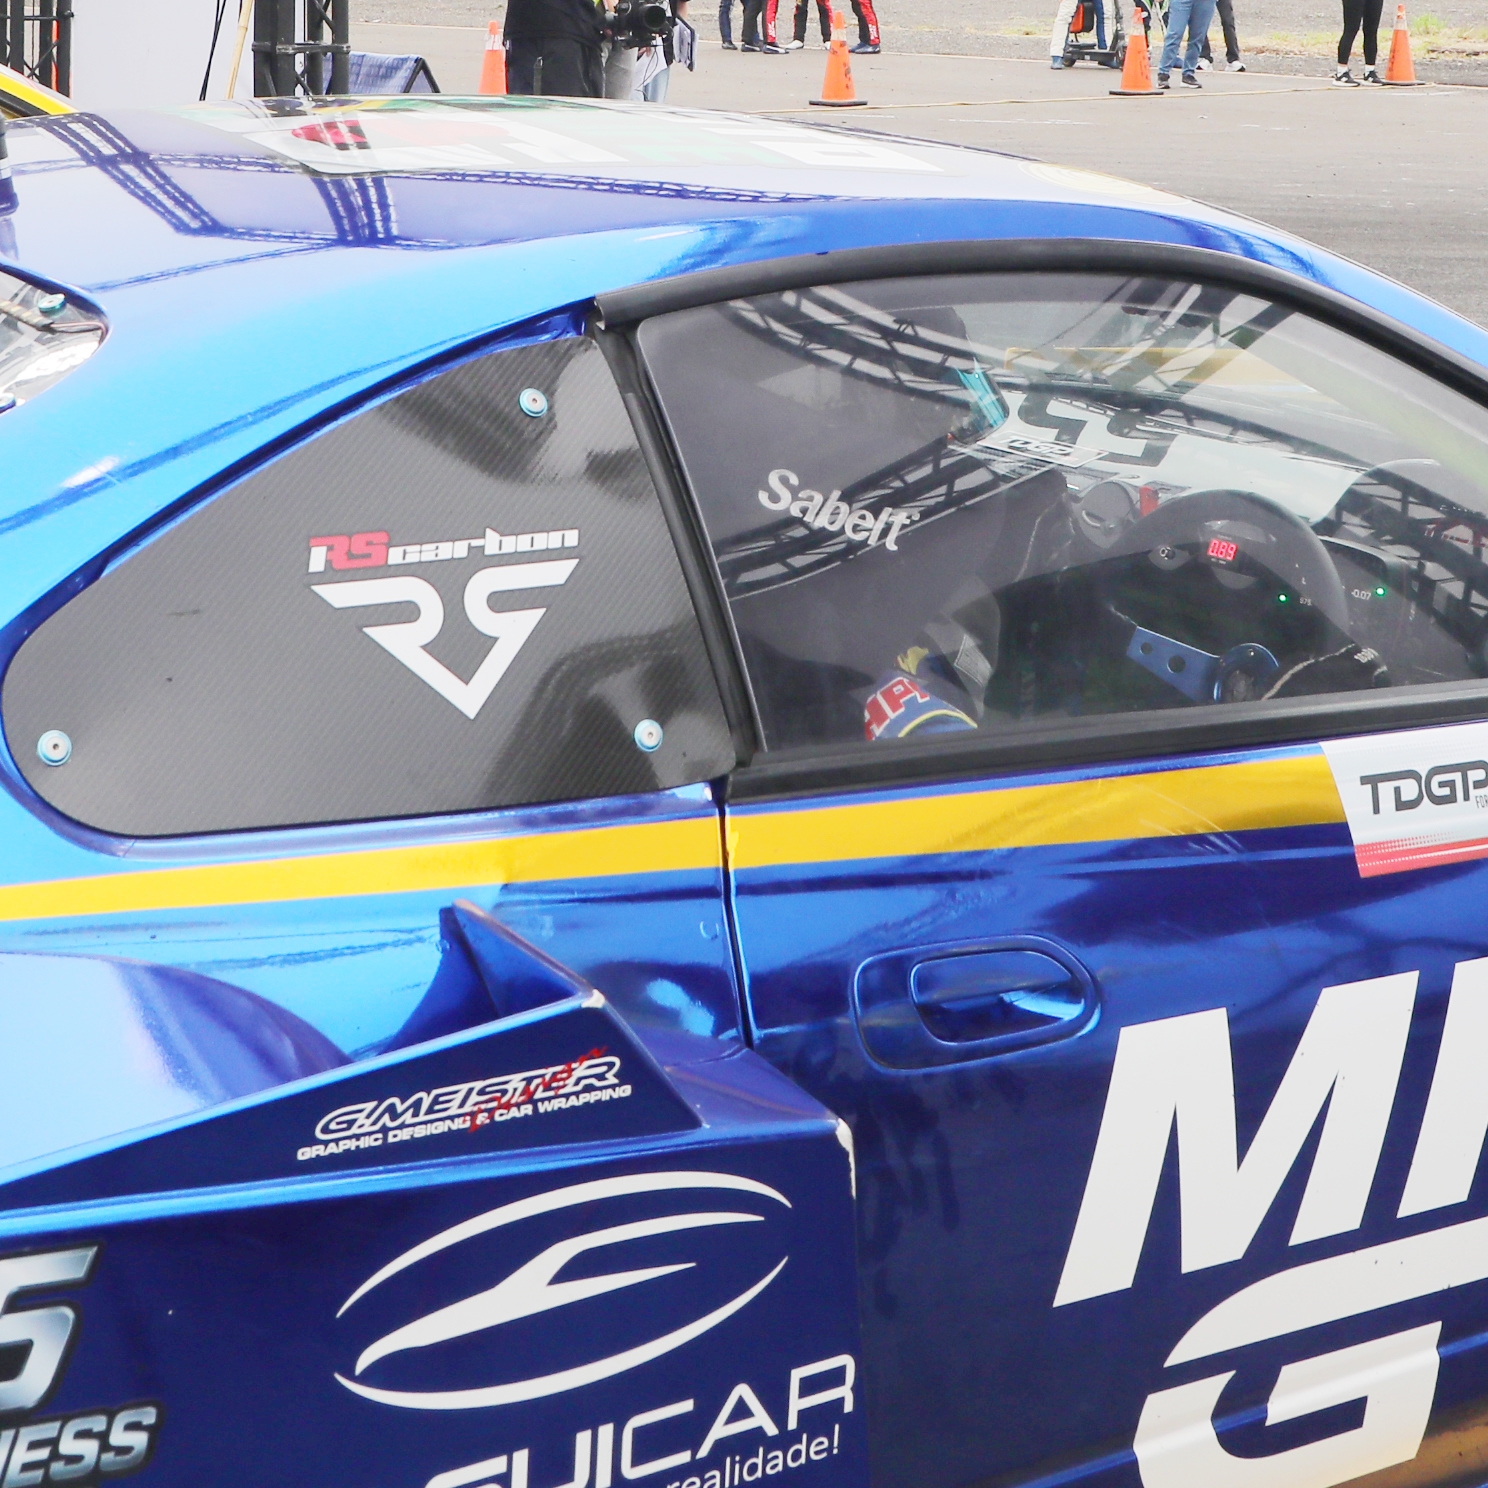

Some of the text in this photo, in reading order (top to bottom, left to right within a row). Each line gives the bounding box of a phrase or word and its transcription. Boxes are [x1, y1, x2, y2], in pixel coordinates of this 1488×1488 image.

[757, 468, 921, 552] Sabelt
[297, 1132, 383, 1161] GRAPHIC
[387, 1115, 472, 1145] DESIGNS
[494, 1103, 533, 1122] CAR
[538, 1084, 632, 1113] WRAPPING
